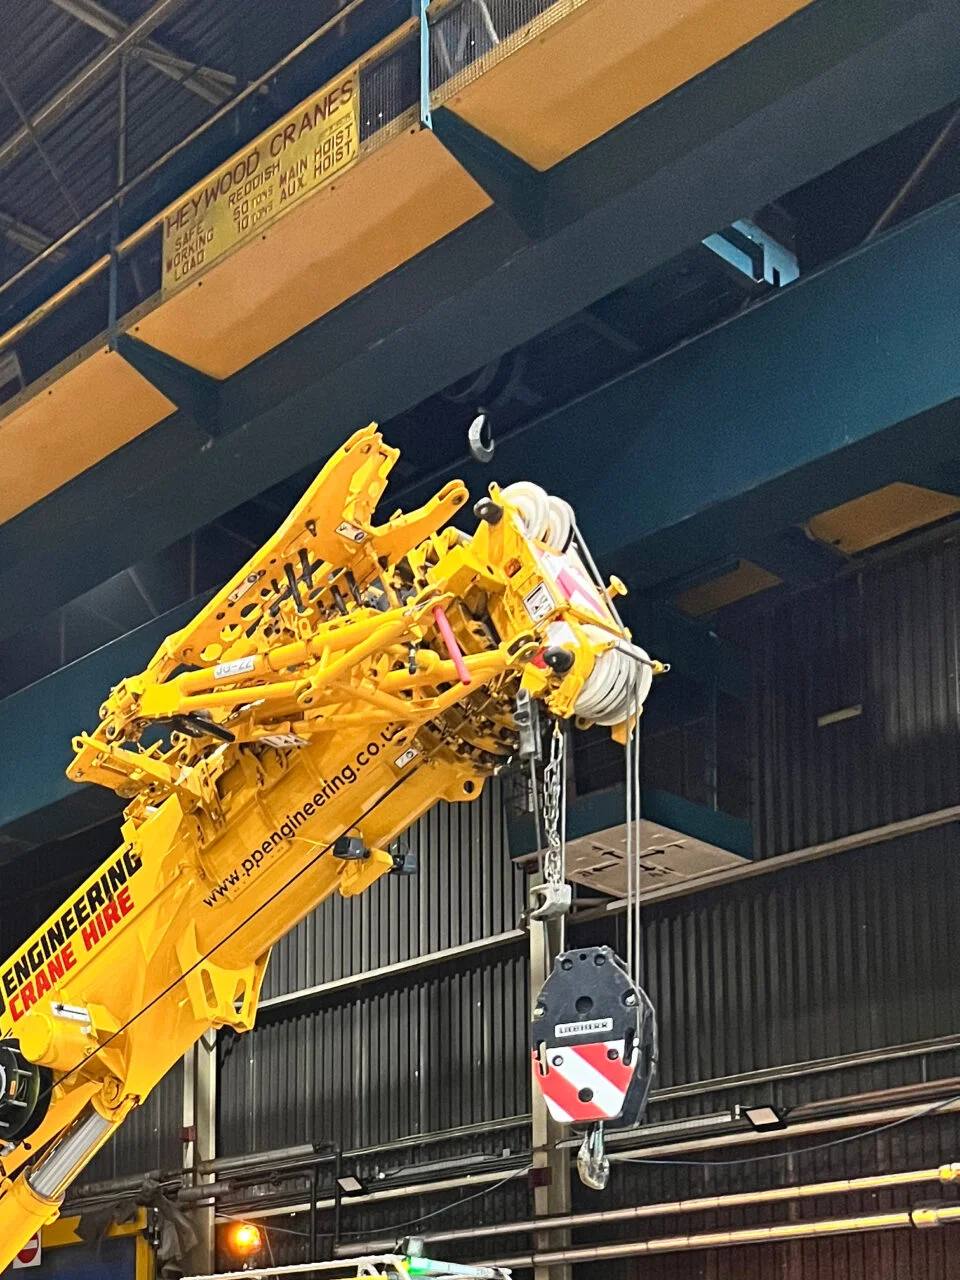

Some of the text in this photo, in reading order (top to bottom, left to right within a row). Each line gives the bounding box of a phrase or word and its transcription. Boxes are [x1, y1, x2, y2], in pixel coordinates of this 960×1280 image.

[166, 80, 354, 239] HEYWOOD CRANES
[233, 199, 249, 222] 50
[279, 157, 308, 187] MAIN
[314, 124, 352, 160] HOIST
[229, 160, 281, 208] REDDISH
[175, 219, 204, 250] SAFE
[237, 215, 249, 233] 10
[166, 228, 214, 273] WORKING
[174, 251, 204, 282] LOAD
[1, 842, 143, 997] ENGINEERING
[8, 885, 135, 1023] CRANE HIRE
